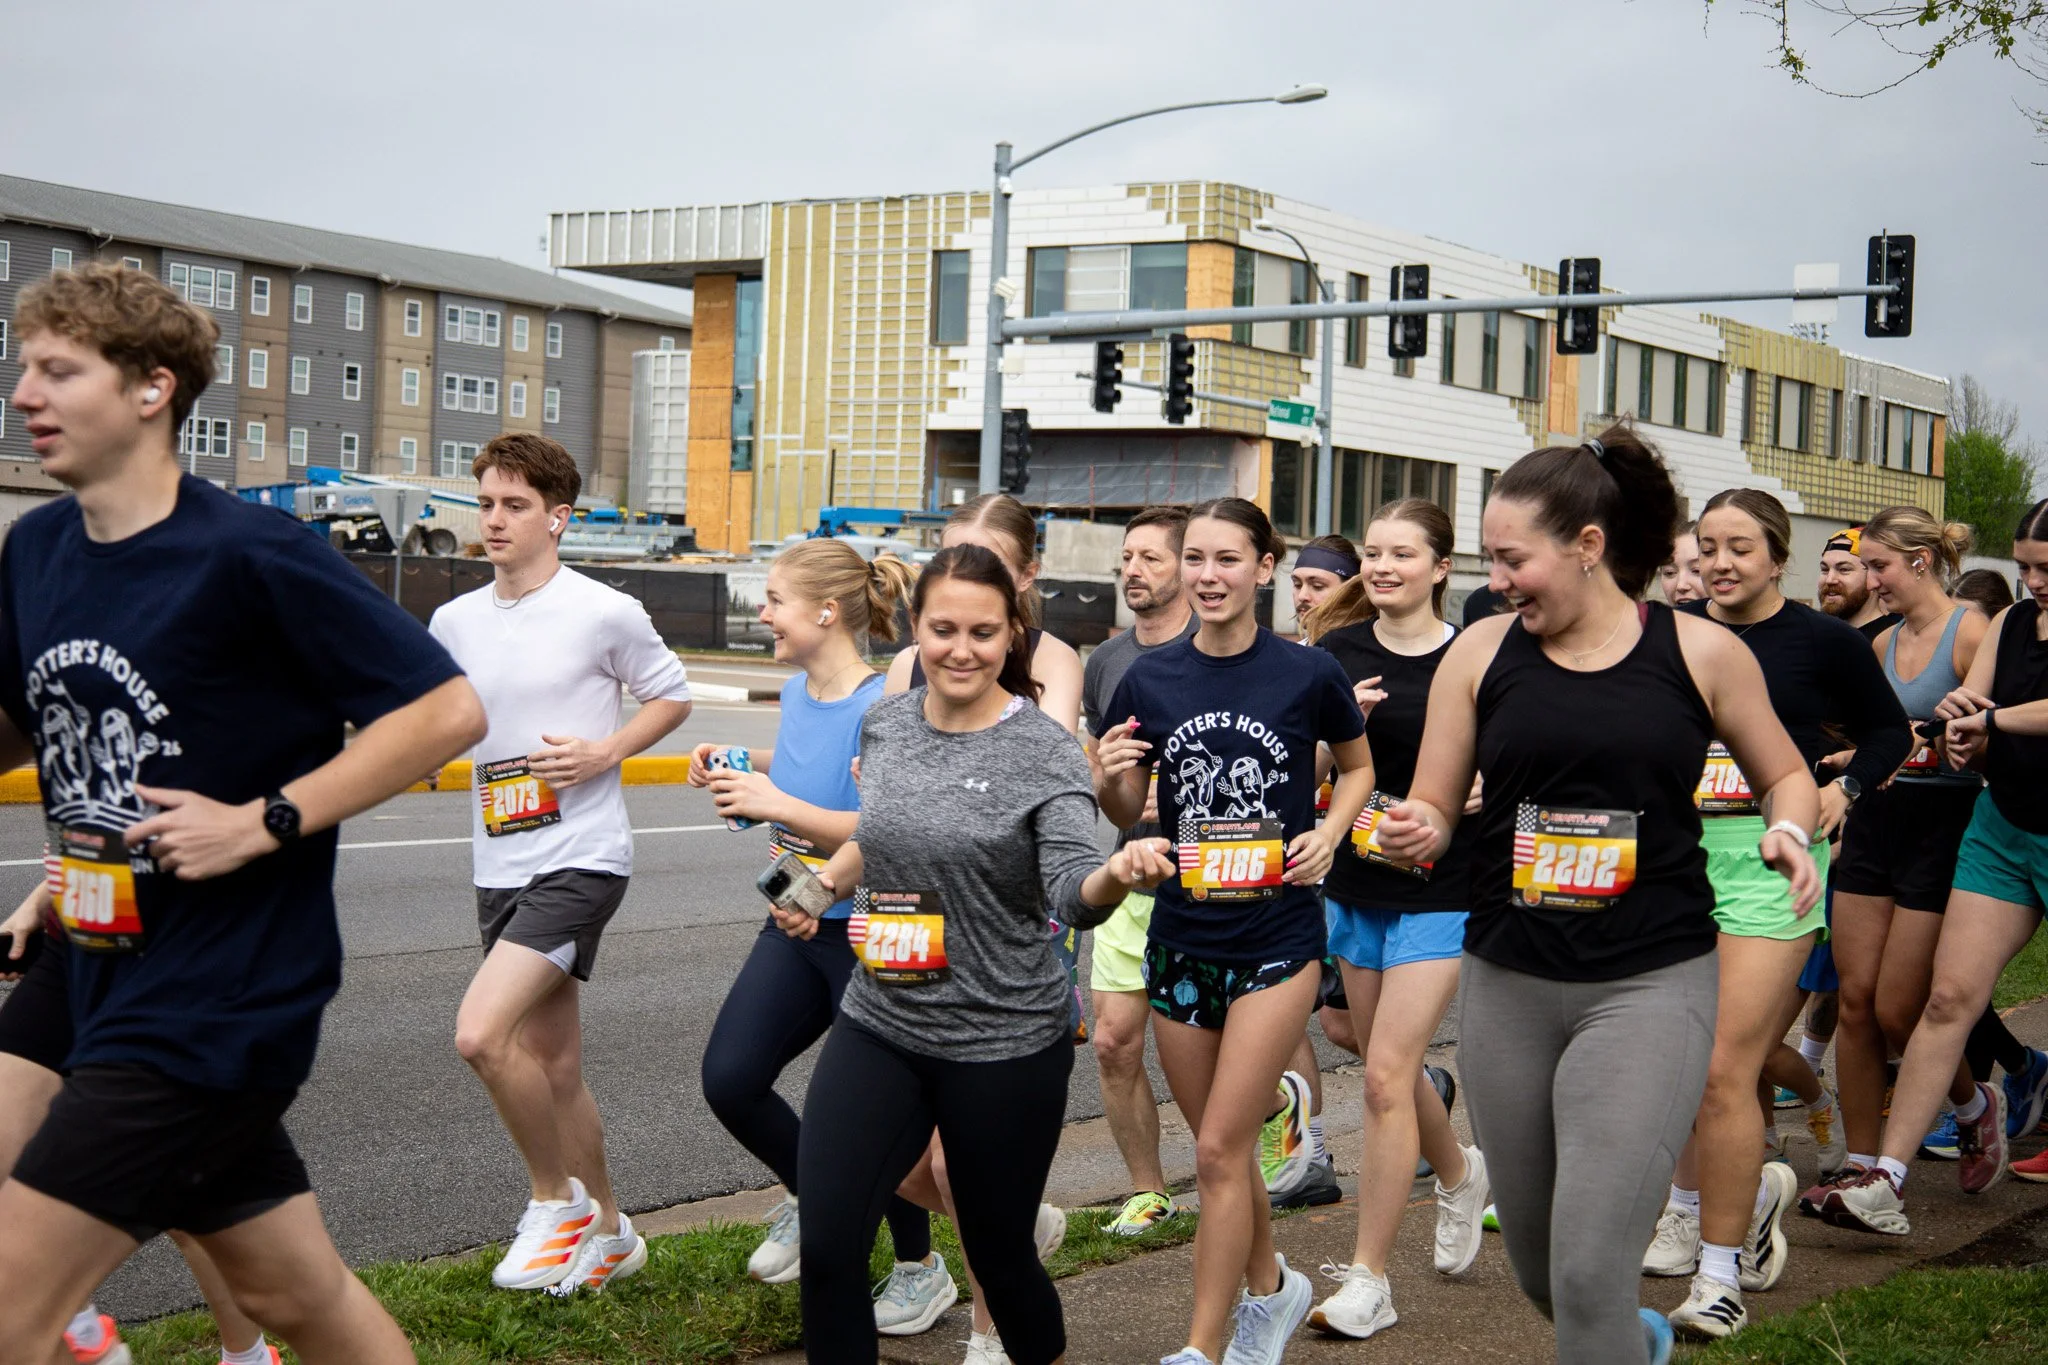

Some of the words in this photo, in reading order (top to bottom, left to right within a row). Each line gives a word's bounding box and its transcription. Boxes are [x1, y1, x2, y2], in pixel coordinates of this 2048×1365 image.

[99, 644, 170, 725] HOUSE
[161, 740, 182, 756] 26
[1164, 711, 1231, 763] POTTER'S
[1235, 714, 1289, 764] HOUSE
[1280, 772, 1289, 783] 26
[493, 780, 540, 817] 2073
[1202, 847, 1267, 882] 2186
[1533, 843, 1620, 888] 2282
[865, 922, 931, 962] 2284
